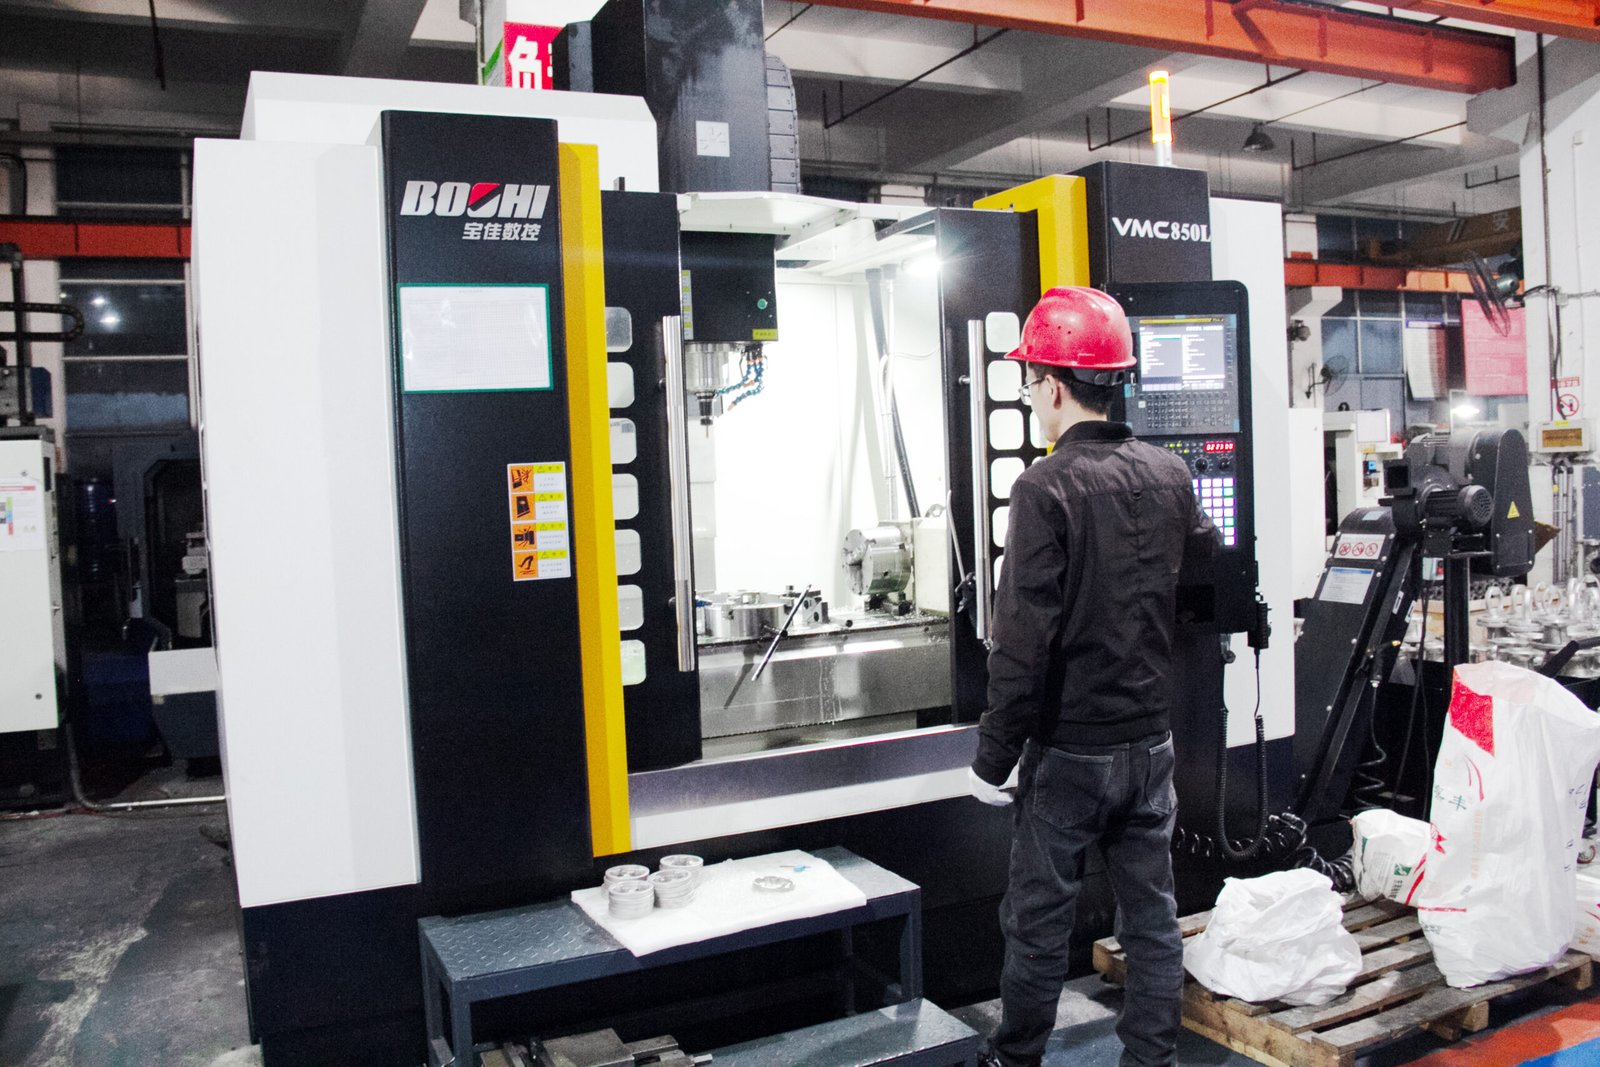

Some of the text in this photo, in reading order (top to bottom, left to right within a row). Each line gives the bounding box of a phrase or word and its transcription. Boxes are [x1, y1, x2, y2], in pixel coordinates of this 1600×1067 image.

[462, 222, 541, 241] 宝佳数控
[1111, 216, 1212, 243] VMC850L
